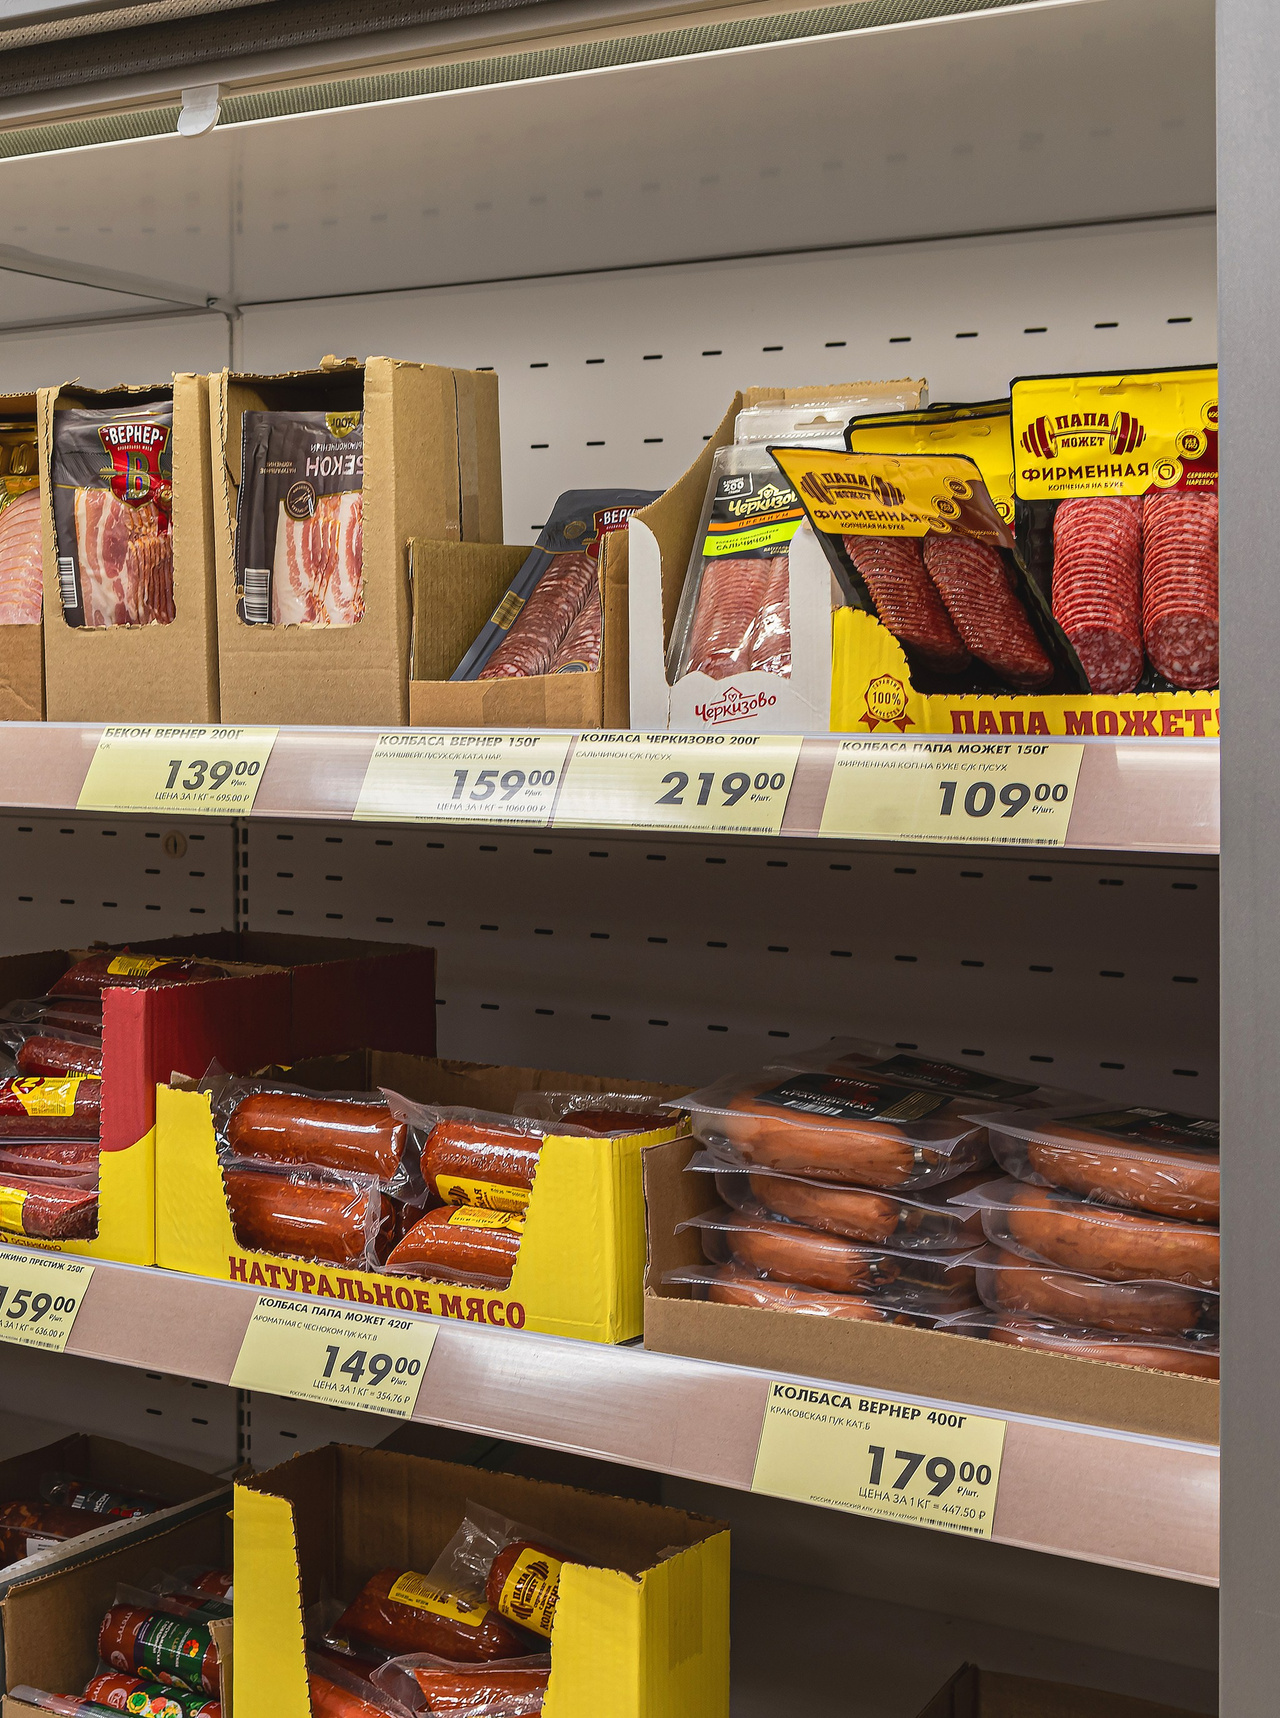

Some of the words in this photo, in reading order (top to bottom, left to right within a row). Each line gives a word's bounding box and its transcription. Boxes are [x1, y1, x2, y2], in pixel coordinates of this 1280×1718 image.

[1055, 413, 1109, 429] ПАПА
[109, 425, 160, 446] ВЕРНЕР
[1061, 437, 1105, 448] МОЖЕТ
[821, 473, 869, 486] ПАПА
[1022, 463, 1149, 481] ФИРМЕННАЯ
[724, 481, 744, 492] 200
[1048, 483, 1090, 491] КОПЧЕНАЯ
[814, 510, 921, 523] ФИРМЕННАЯ
[695, 691, 776, 723] Черкизово
[872, 691, 901, 706] 100%
[950, 710, 1050, 735] ПАПА
[105, 728, 151, 739] БЕКОН
[154, 728, 207, 739] ВЕРНЕР
[210, 729, 244, 740] 200Г
[379, 735, 445, 745] КОЛБАСА
[450, 736, 503, 747] ВЕРНЕР
[509, 737, 541, 747] 150Г
[581, 734, 641, 743] КОЛБАСА
[647, 735, 725, 745] ЧЕРКИЗОВО
[729, 736, 761, 745] 200Г
[576, 751, 628, 759] САЛЬЧИЧОН
[842, 742, 907, 752] КОЛБАСА
[912, 743, 953, 754] ПАПА
[957, 744, 1011, 755] МОЖЕТ
[1017, 745, 1049, 755] 150Г
[838, 760, 896, 769] ФИРМЕННАЯ
[165, 760, 233, 790] 139
[235, 761, 261, 776] 00
[451, 770, 526, 801] 159
[527, 770, 556, 786] 00
[655, 771, 751, 807] 219
[754, 772, 786, 790] 00
[155, 792, 178, 800] ЦЕНА
[939, 781, 1031, 818] 109
[1034, 783, 1069, 802] 00
[30, 1257, 65, 1271] ПРЕСТИЖ
[67, 1264, 84, 1273] 250Г
[228, 1255, 434, 1315] НАТУРАЛЬНОЕ
[440, 1293, 526, 1329] МЯСО
[53, 1296, 76, 1313] 00
[258, 1297, 308, 1313] КОЛБАСА
[311, 1306, 342, 1319] ПАПА
[345, 1312, 385, 1326] МОЖЕТ
[387, 1319, 414, 1331] 420Г
[4, 1320, 14, 1328] ЗА
[253, 1315, 296, 1328] АРОМАТНАЯ
[303, 1322, 343, 1336] ЧЕСНОКОМ
[322, 1345, 392, 1386] 149
[394, 1357, 421, 1376] 00
[313, 1379, 338, 1392] ЦЕНА
[339, 1384, 351, 1394] ЗА
[357, 1388, 368, 1396] КГ
[773, 1384, 852, 1410] КОЛБАСА
[858, 1399, 921, 1420] ВЕРНЕР
[926, 1411, 967, 1429] 400Г
[770, 1405, 827, 1423] КРАКОВСКАЯ
[828, 1415, 844, 1426] П/К
[868, 1444, 956, 1497] 179
[959, 1461, 992, 1486] 00
[957, 1486, 979, 1498] ₽/шт.
[858, 1487, 891, 1503] ЦЕНА
[893, 1492, 908, 1504] ЗА
[916, 1497, 931, 1510] КГ
[941, 1502, 976, 1518] 447.50
